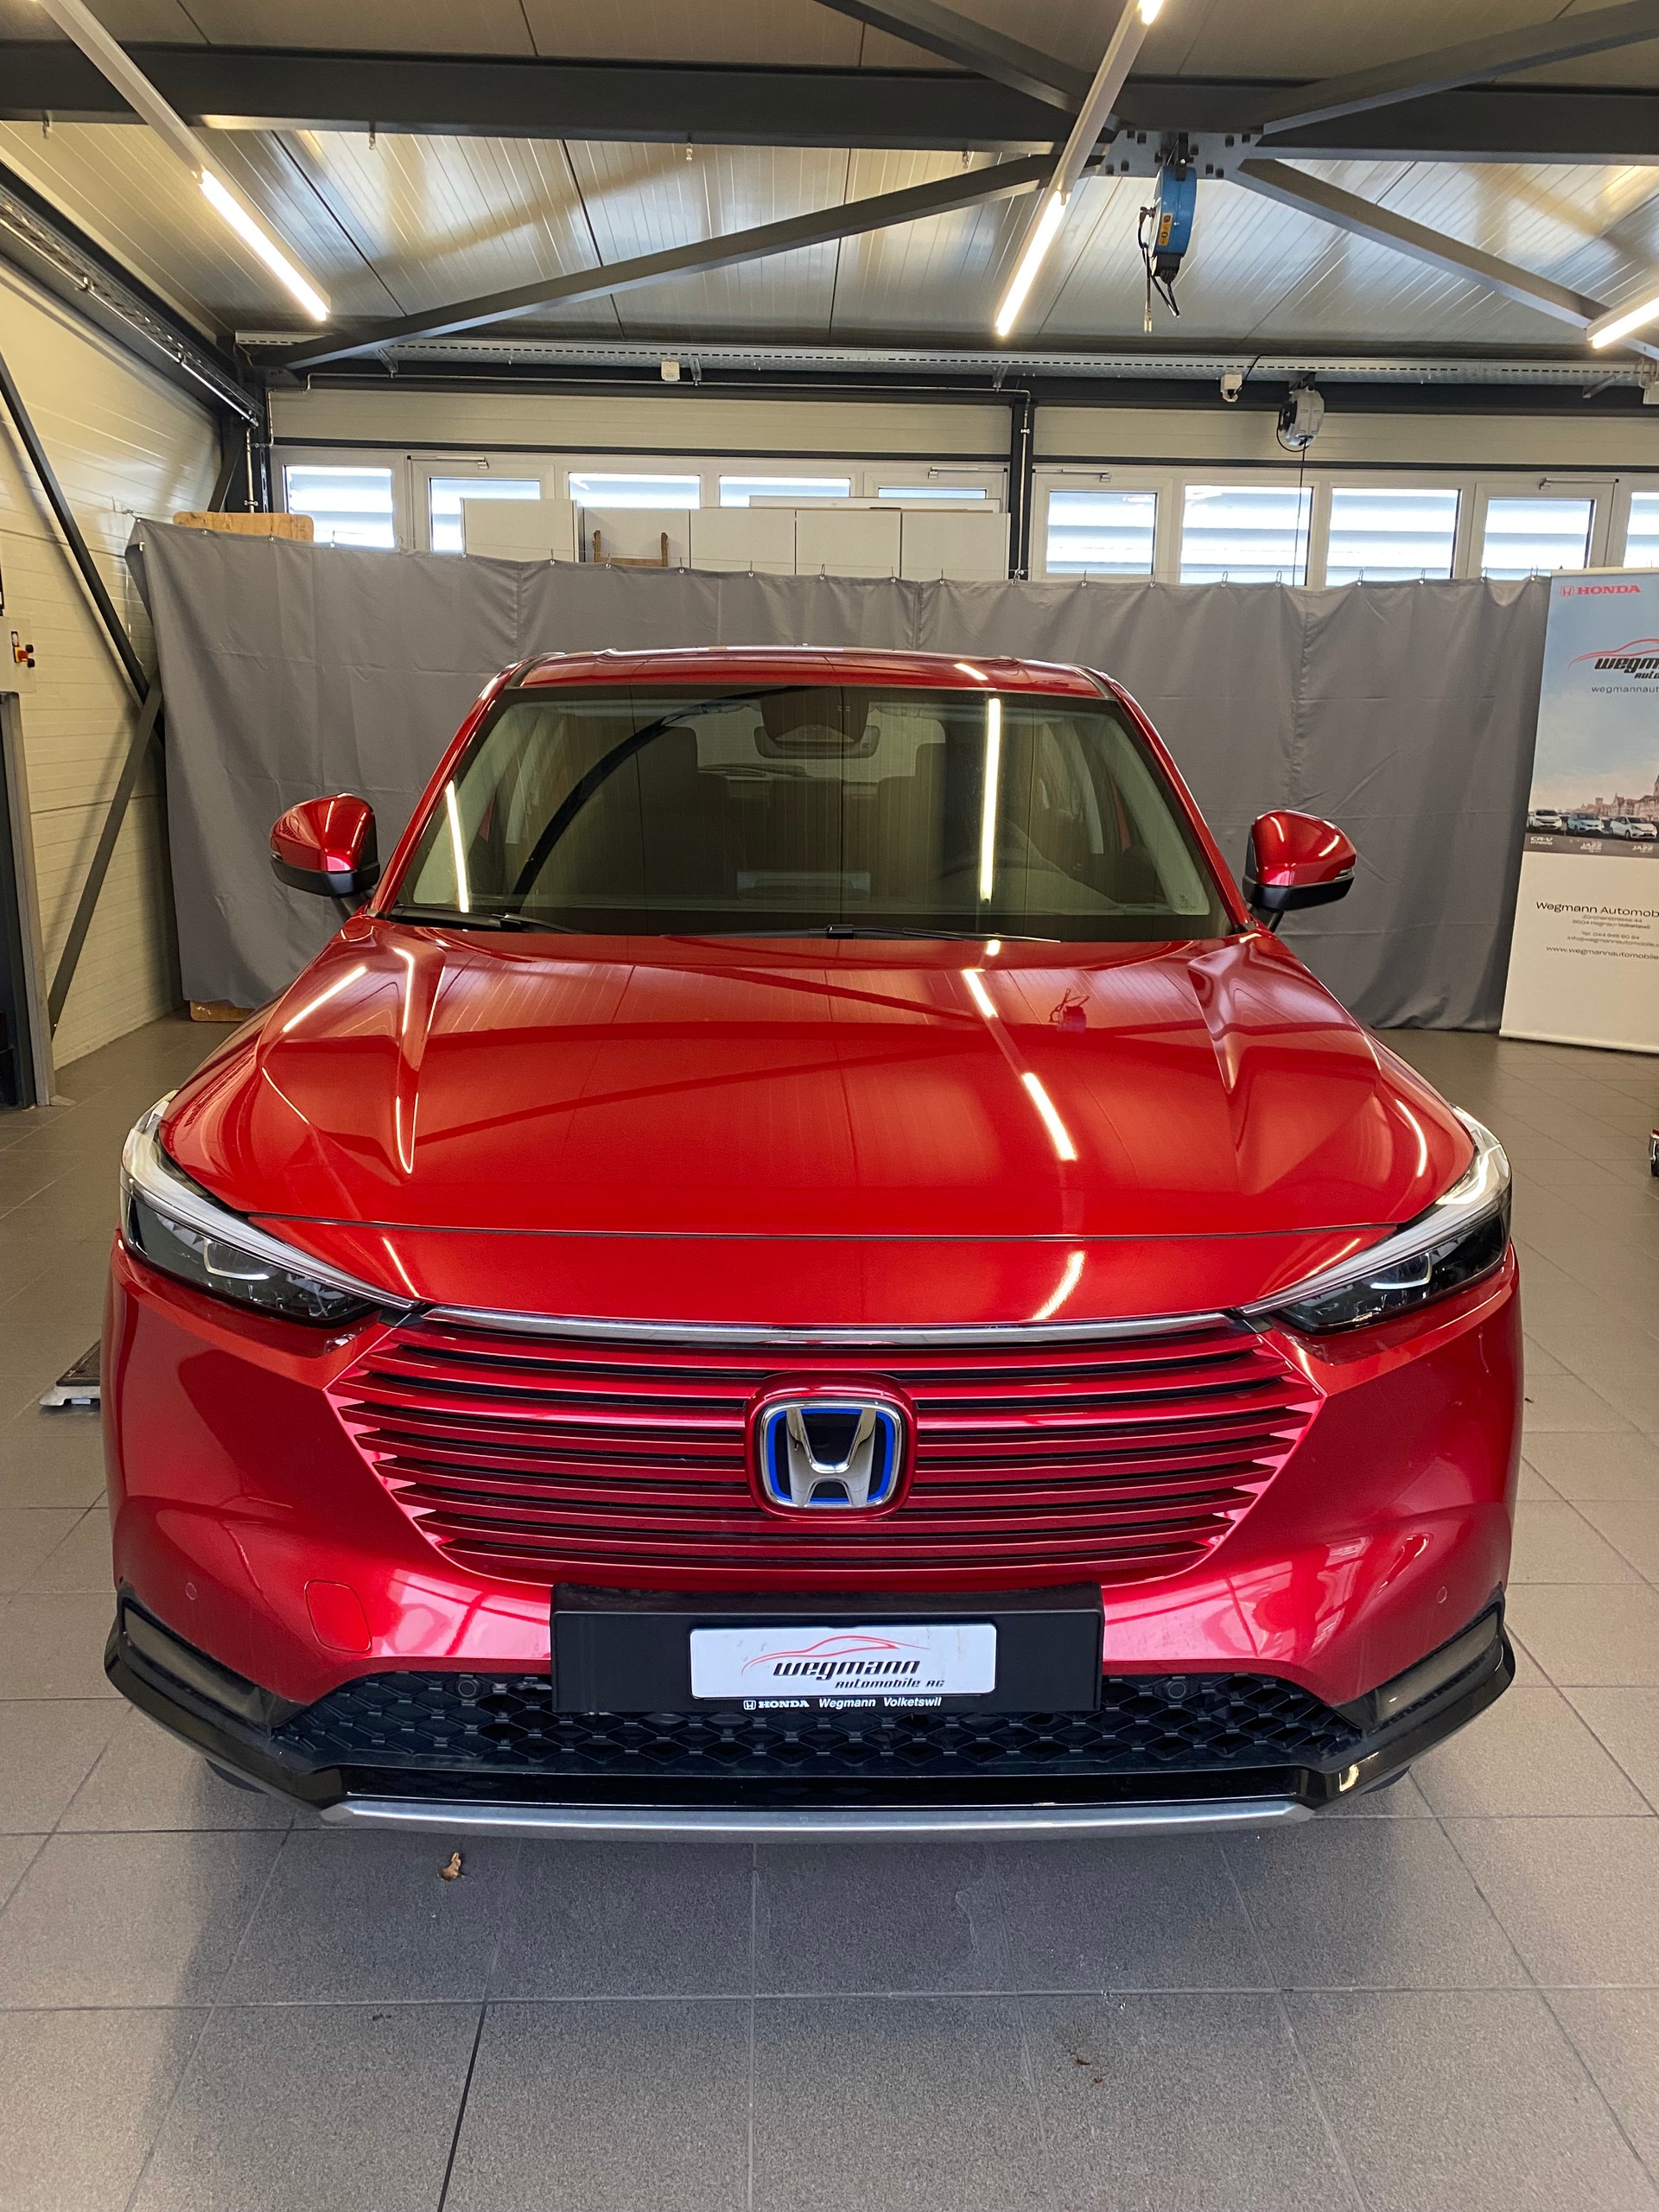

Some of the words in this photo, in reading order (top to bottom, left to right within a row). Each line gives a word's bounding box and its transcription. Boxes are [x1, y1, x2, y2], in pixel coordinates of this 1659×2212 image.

[1577, 584, 1641, 595] HONDA
[1594, 658, 1659, 674] wegm
[1535, 901, 1598, 913] Wegmann
[772, 1659, 920, 1681] wegmann
[835, 1678, 920, 1689] automobile
[925, 1679, 944, 1688] AG
[758, 1700, 810, 1709] HONDA
[818, 1697, 876, 1710] Wegmann
[883, 1696, 942, 1708] Volketswil
